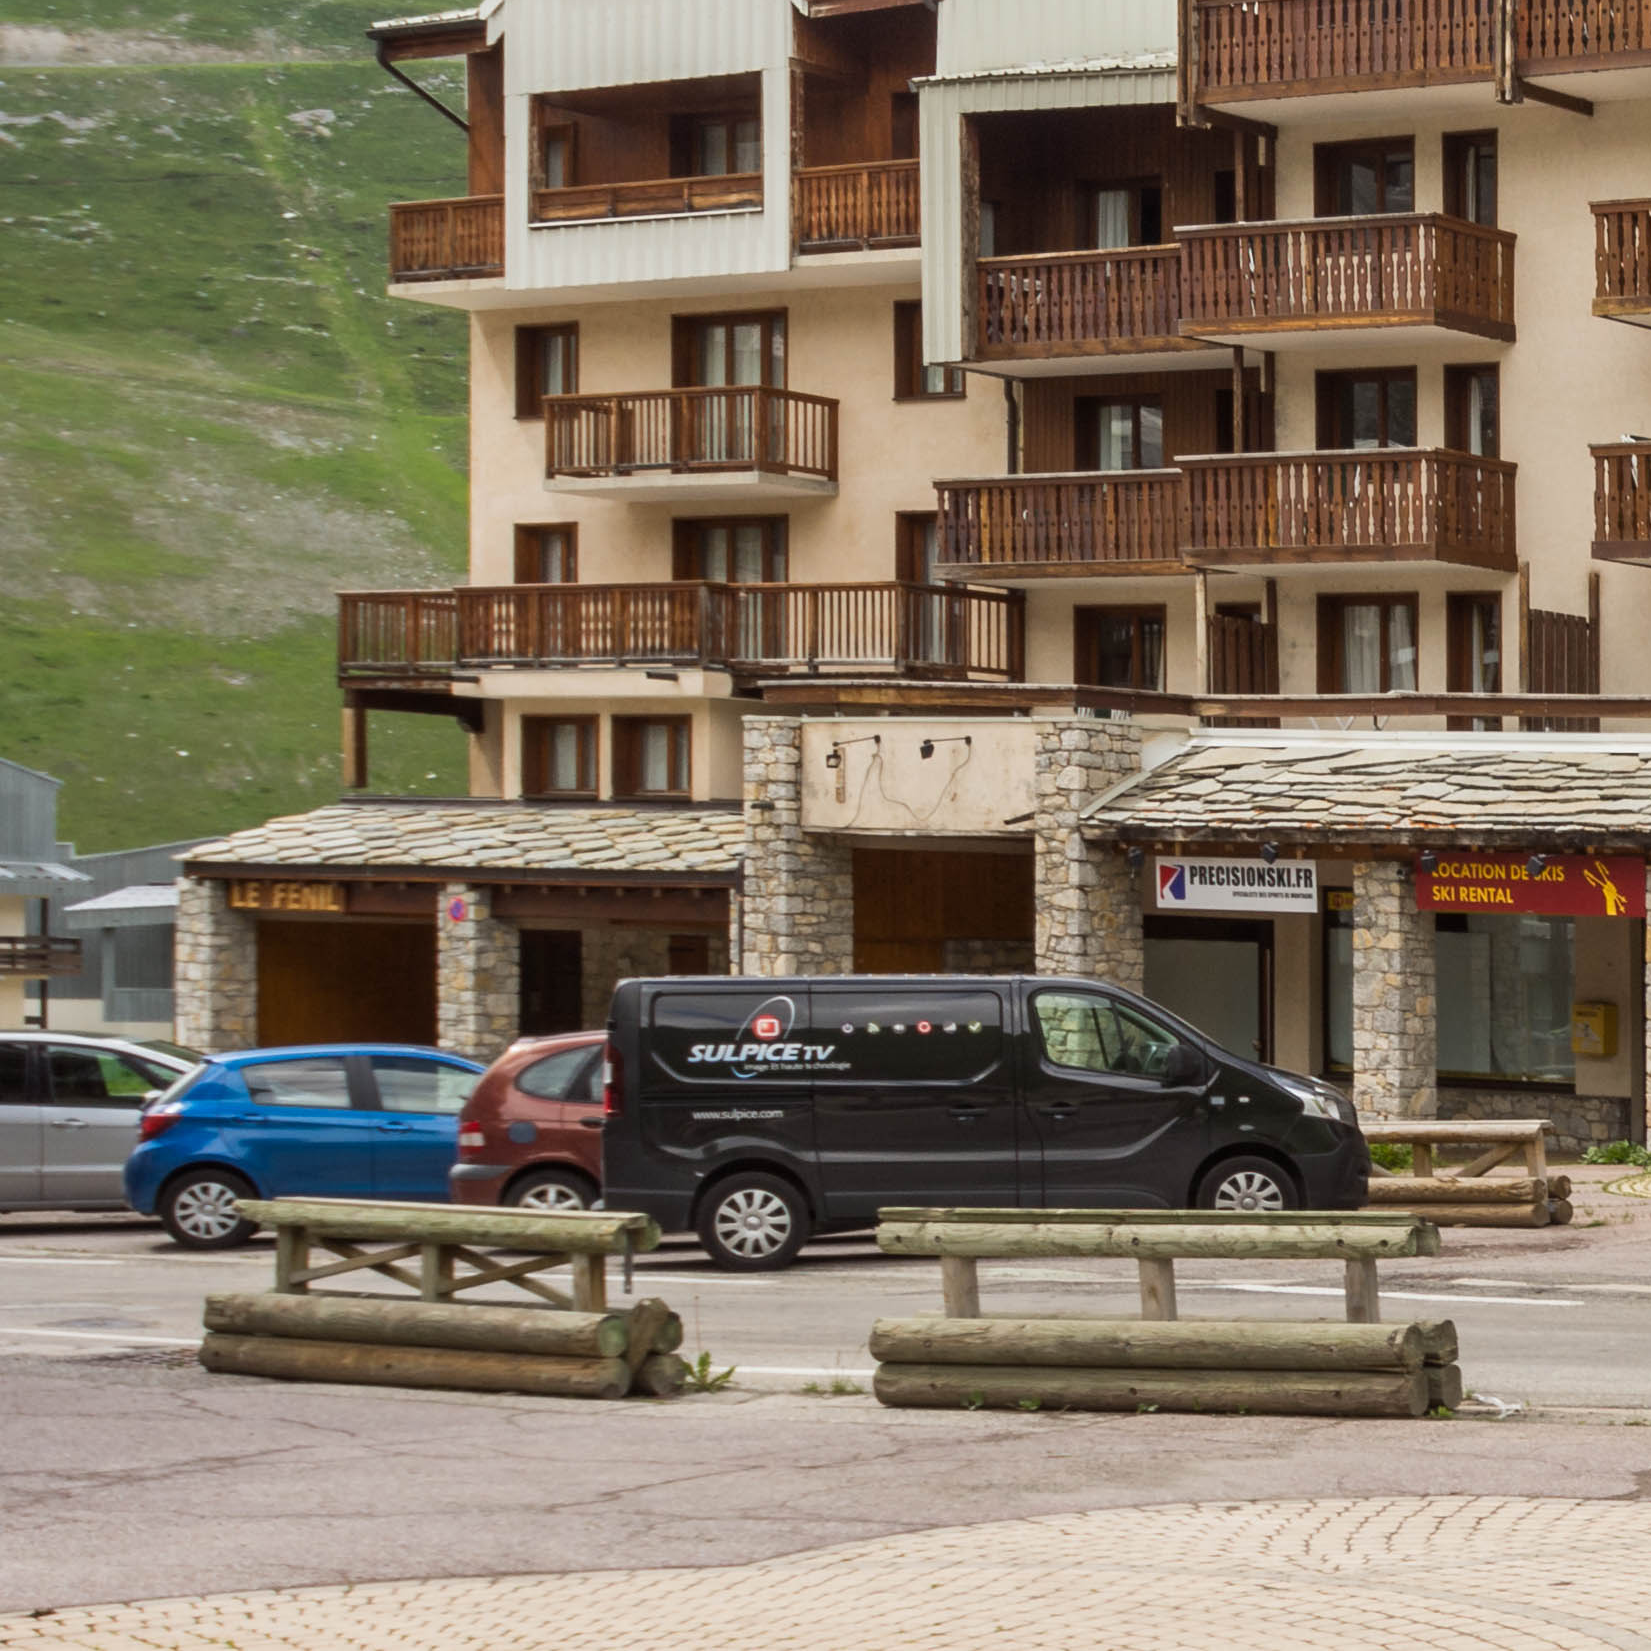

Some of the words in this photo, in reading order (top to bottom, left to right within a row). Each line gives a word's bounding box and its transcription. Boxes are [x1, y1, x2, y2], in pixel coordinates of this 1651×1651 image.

[1189, 864, 1314, 889] PRECISIONSKI.FR
[1510, 865, 1529, 880] DE
[232, 883, 259, 908] LE
[272, 883, 339, 911] FENIL
[1432, 886, 1455, 901] SKI
[1460, 887, 1514, 904] RENTAL
[687, 1043, 802, 1062] SULPICE
[803, 1045, 835, 1060] TV
[692, 1109, 784, 1122] www.sulpice.com
